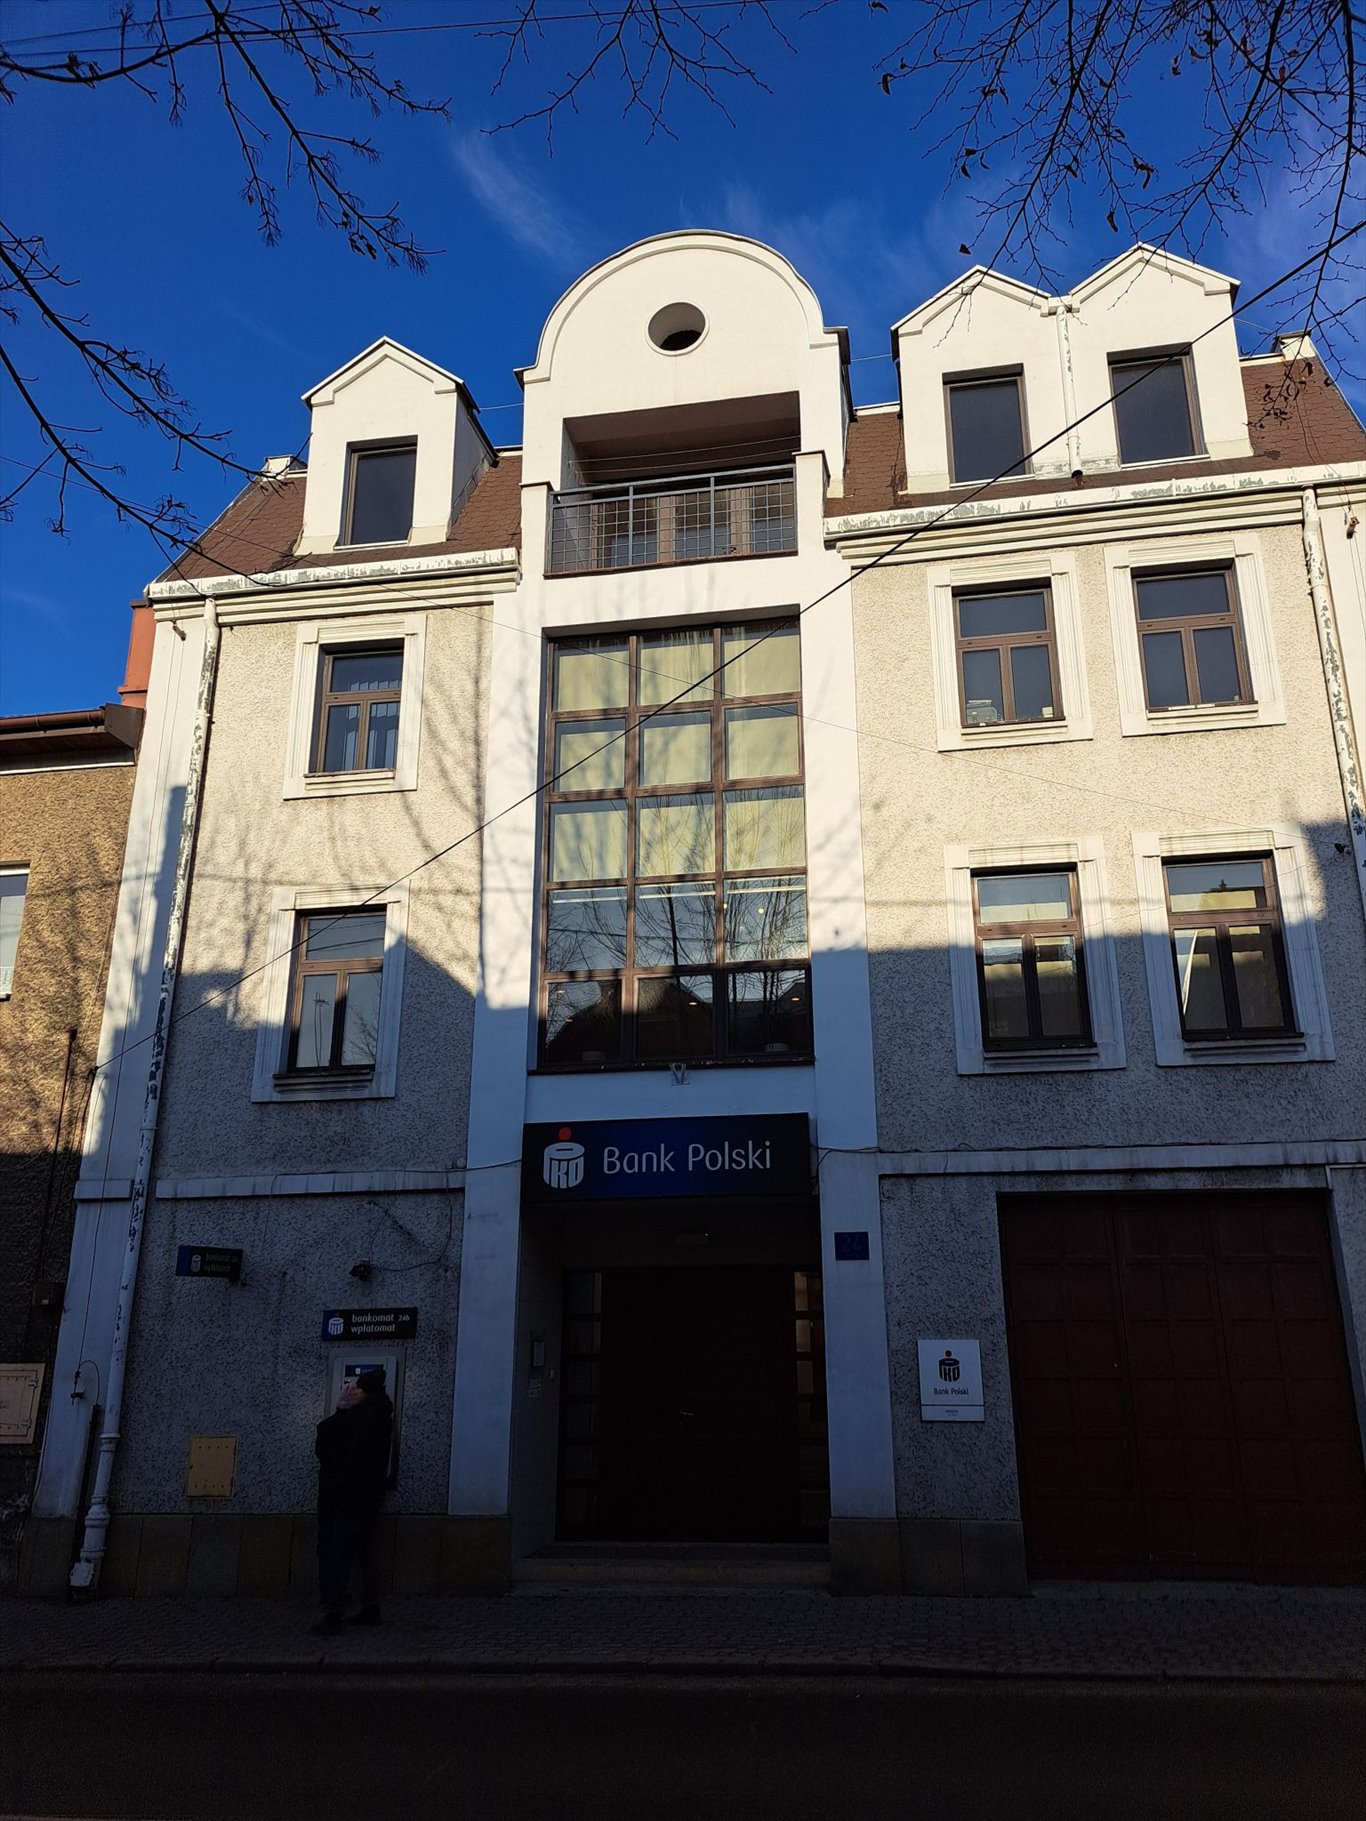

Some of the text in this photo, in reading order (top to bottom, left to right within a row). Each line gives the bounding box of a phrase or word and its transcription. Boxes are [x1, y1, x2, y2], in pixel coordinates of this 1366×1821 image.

[602, 1140, 771, 1175] Bank Polski
[351, 1313, 410, 1323] bankomat 24h
[933, 1387, 969, 1395] Bank Polski
